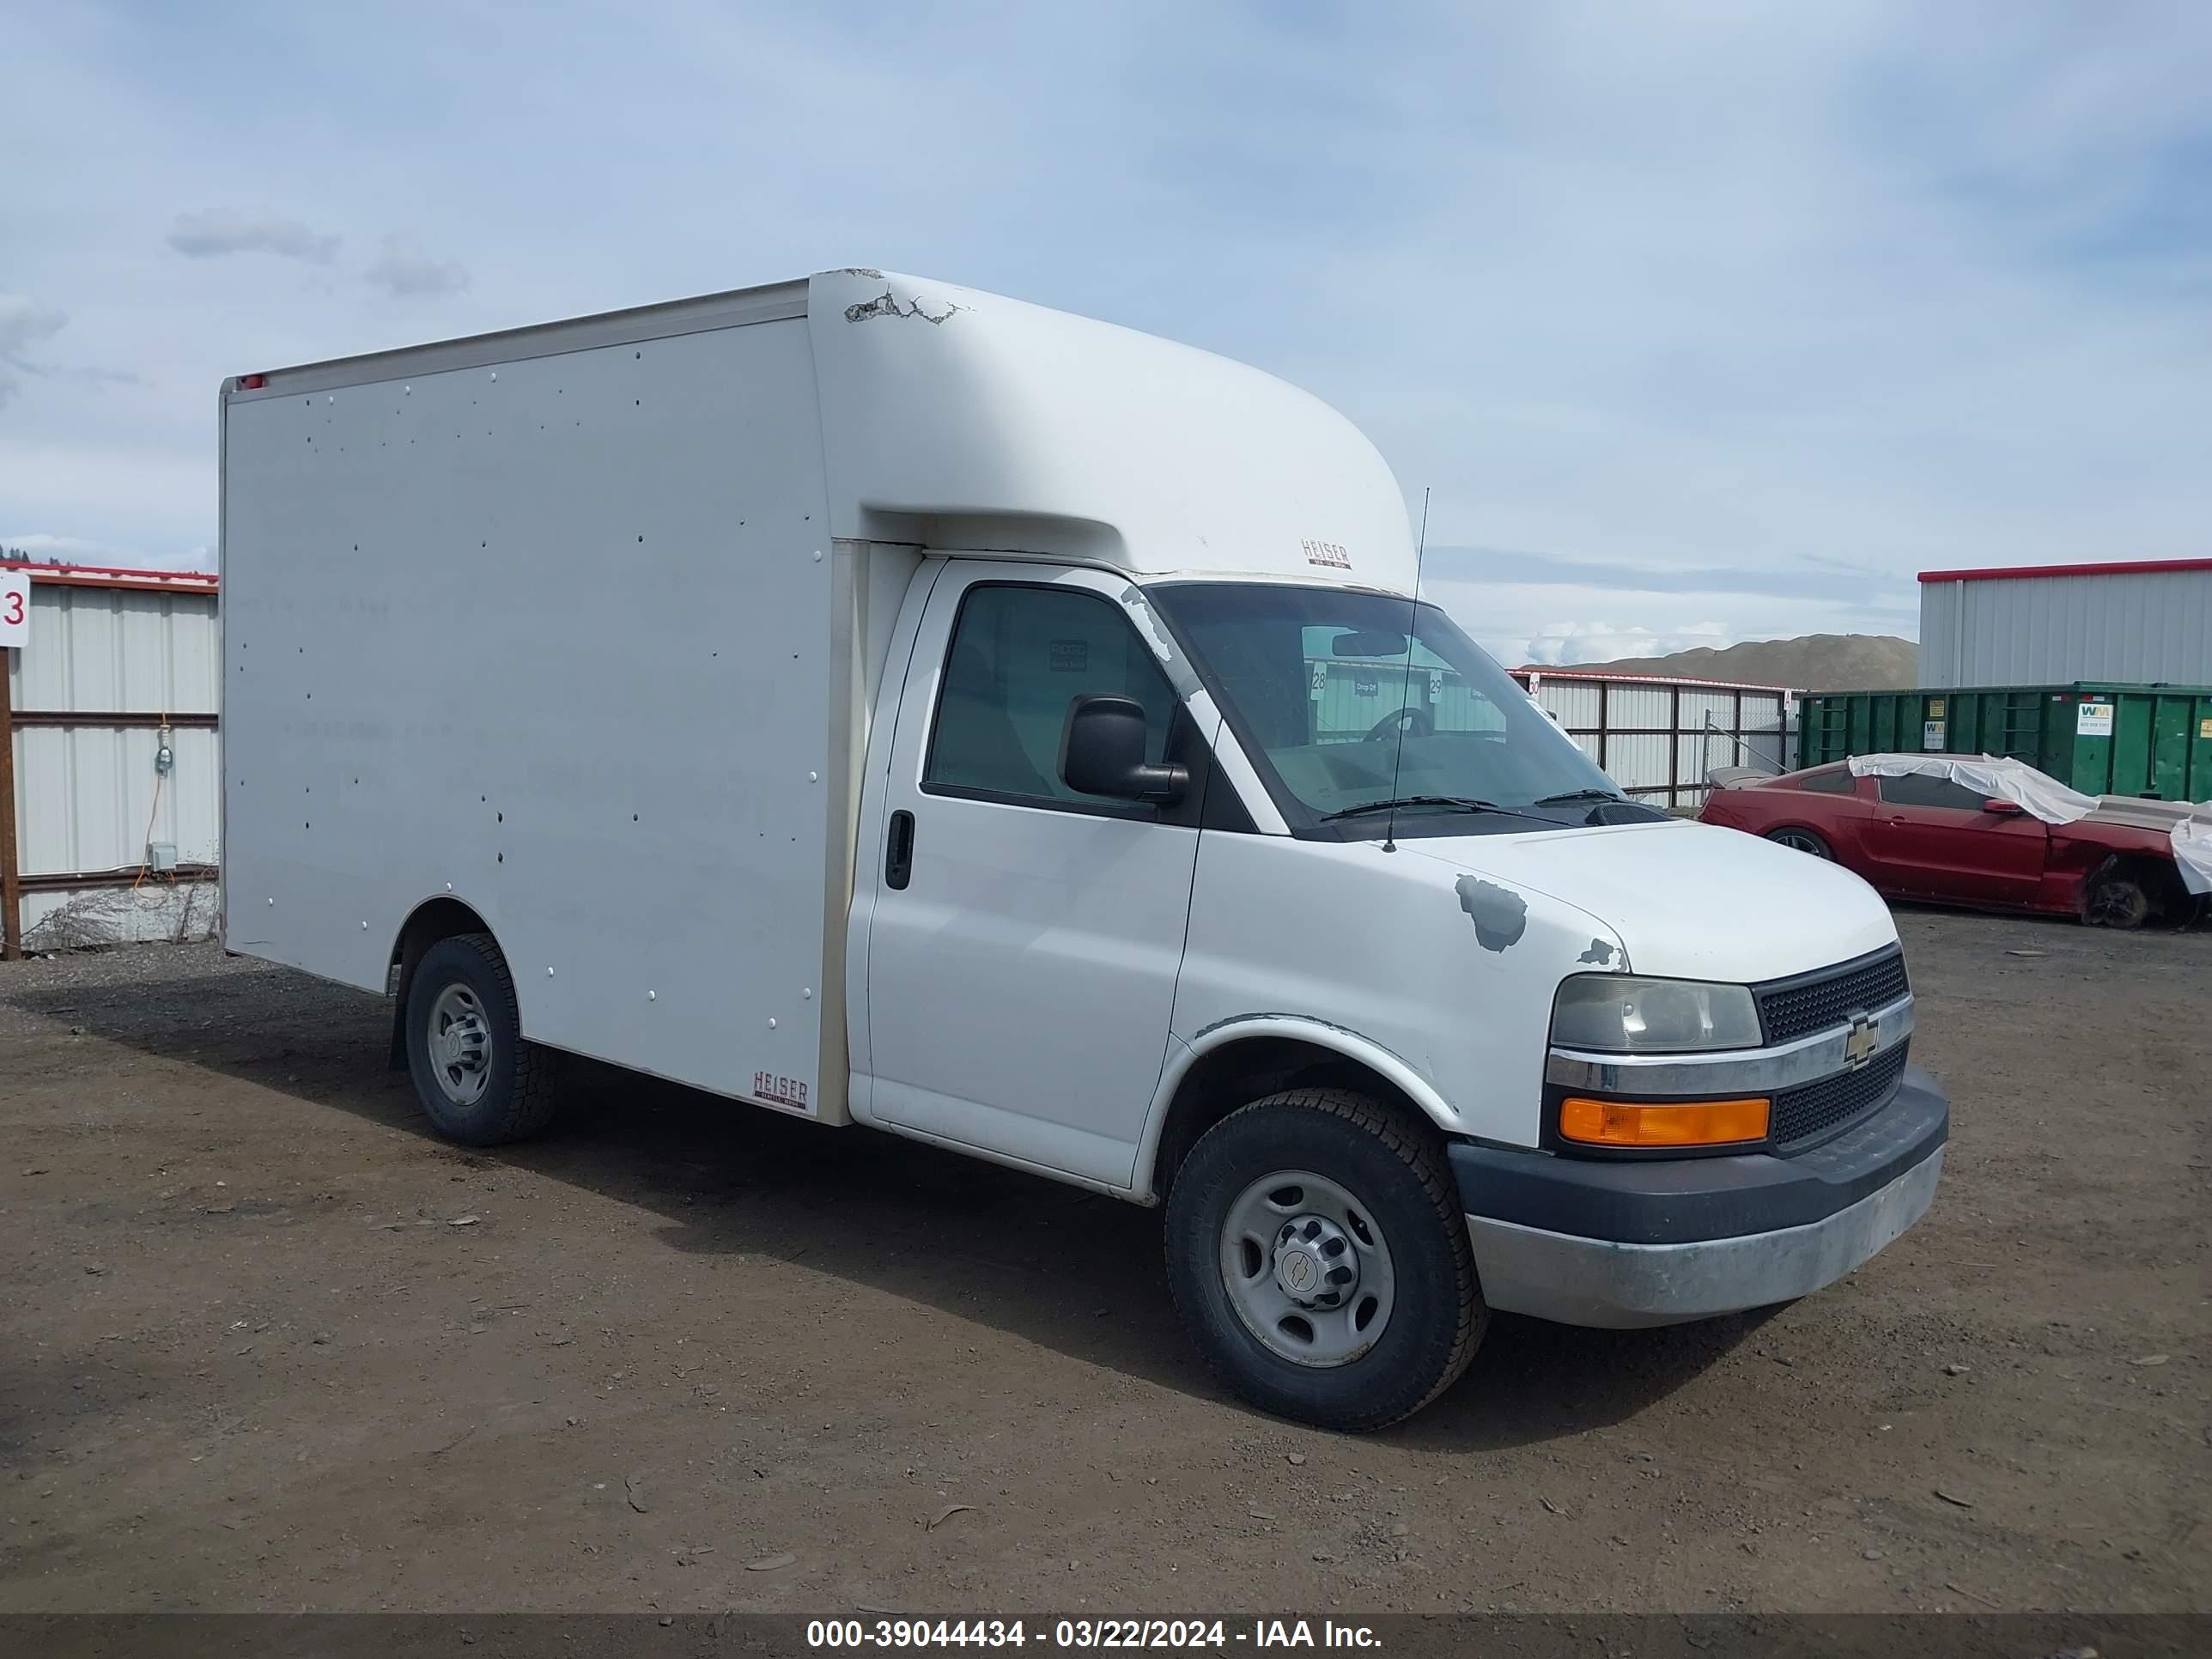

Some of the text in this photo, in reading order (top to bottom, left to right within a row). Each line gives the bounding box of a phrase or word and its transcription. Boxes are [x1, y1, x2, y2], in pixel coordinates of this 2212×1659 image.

[1300, 538, 1351, 563] HEISER
[1312, 672, 1325, 690] 28
[1430, 679, 1442, 694] 29
[1529, 681, 1539, 695] 30
[2081, 706, 2109, 716] WM
[1926, 723, 1944, 732] WM
[754, 1071, 808, 1103] HEISER
